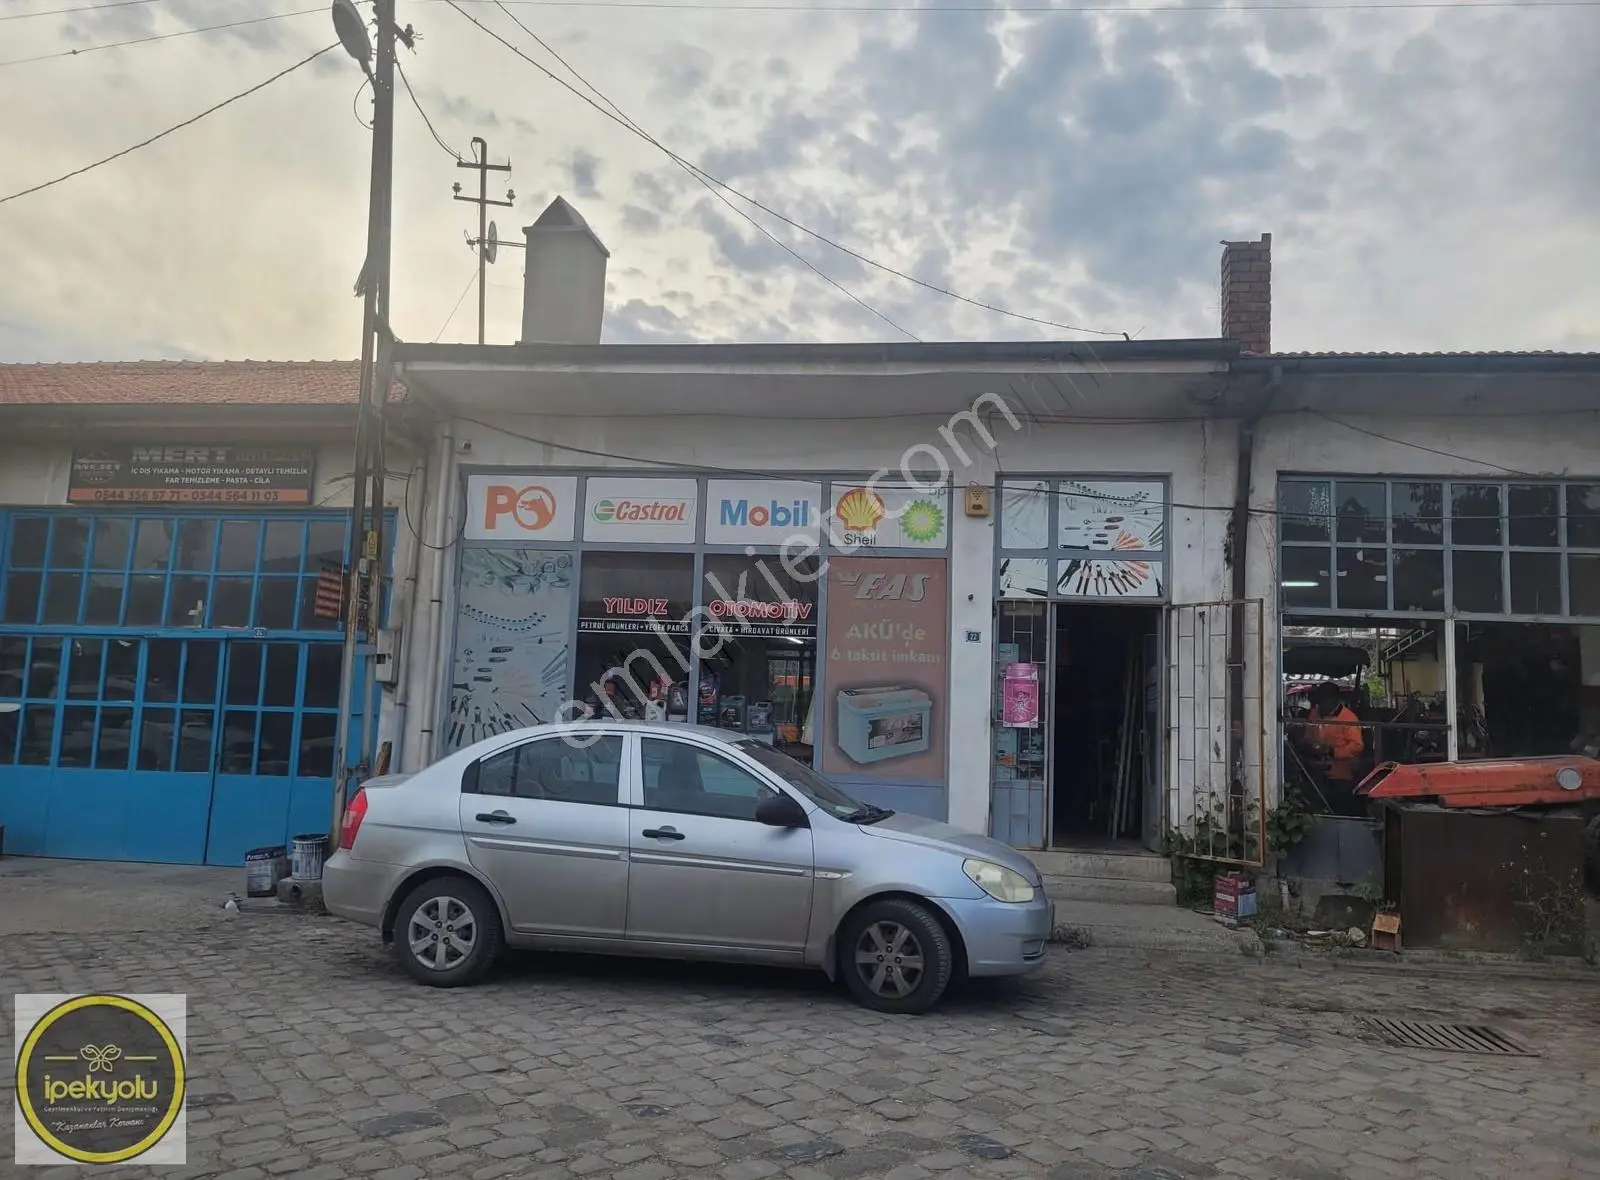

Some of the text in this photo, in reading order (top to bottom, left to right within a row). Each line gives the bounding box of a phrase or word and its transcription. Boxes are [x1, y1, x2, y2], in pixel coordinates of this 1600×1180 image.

[132, 446, 233, 462] MERT
[152, 467, 180, 475] YIKAMA
[185, 467, 212, 475] MOTOR
[213, 467, 240, 475] YIKAMA
[245, 467, 275, 475] DETAYLI
[165, 477, 180, 485] FAR
[225, 477, 248, 485] PASTA
[94, 490, 125, 500] 0544
[191, 490, 222, 500] 0544
[615, 500, 687, 521] Castrol
[720, 499, 809, 529] Mobil
[844, 533, 876, 545] Shell
[603, 597, 812, 619] YILDIZ OTOMOTİV
[580, 621, 605, 630] PETROL
[644, 623, 665, 632] YEDEK
[846, 618, 927, 641] AKÜ'de
[847, 648, 887, 662] taksit
